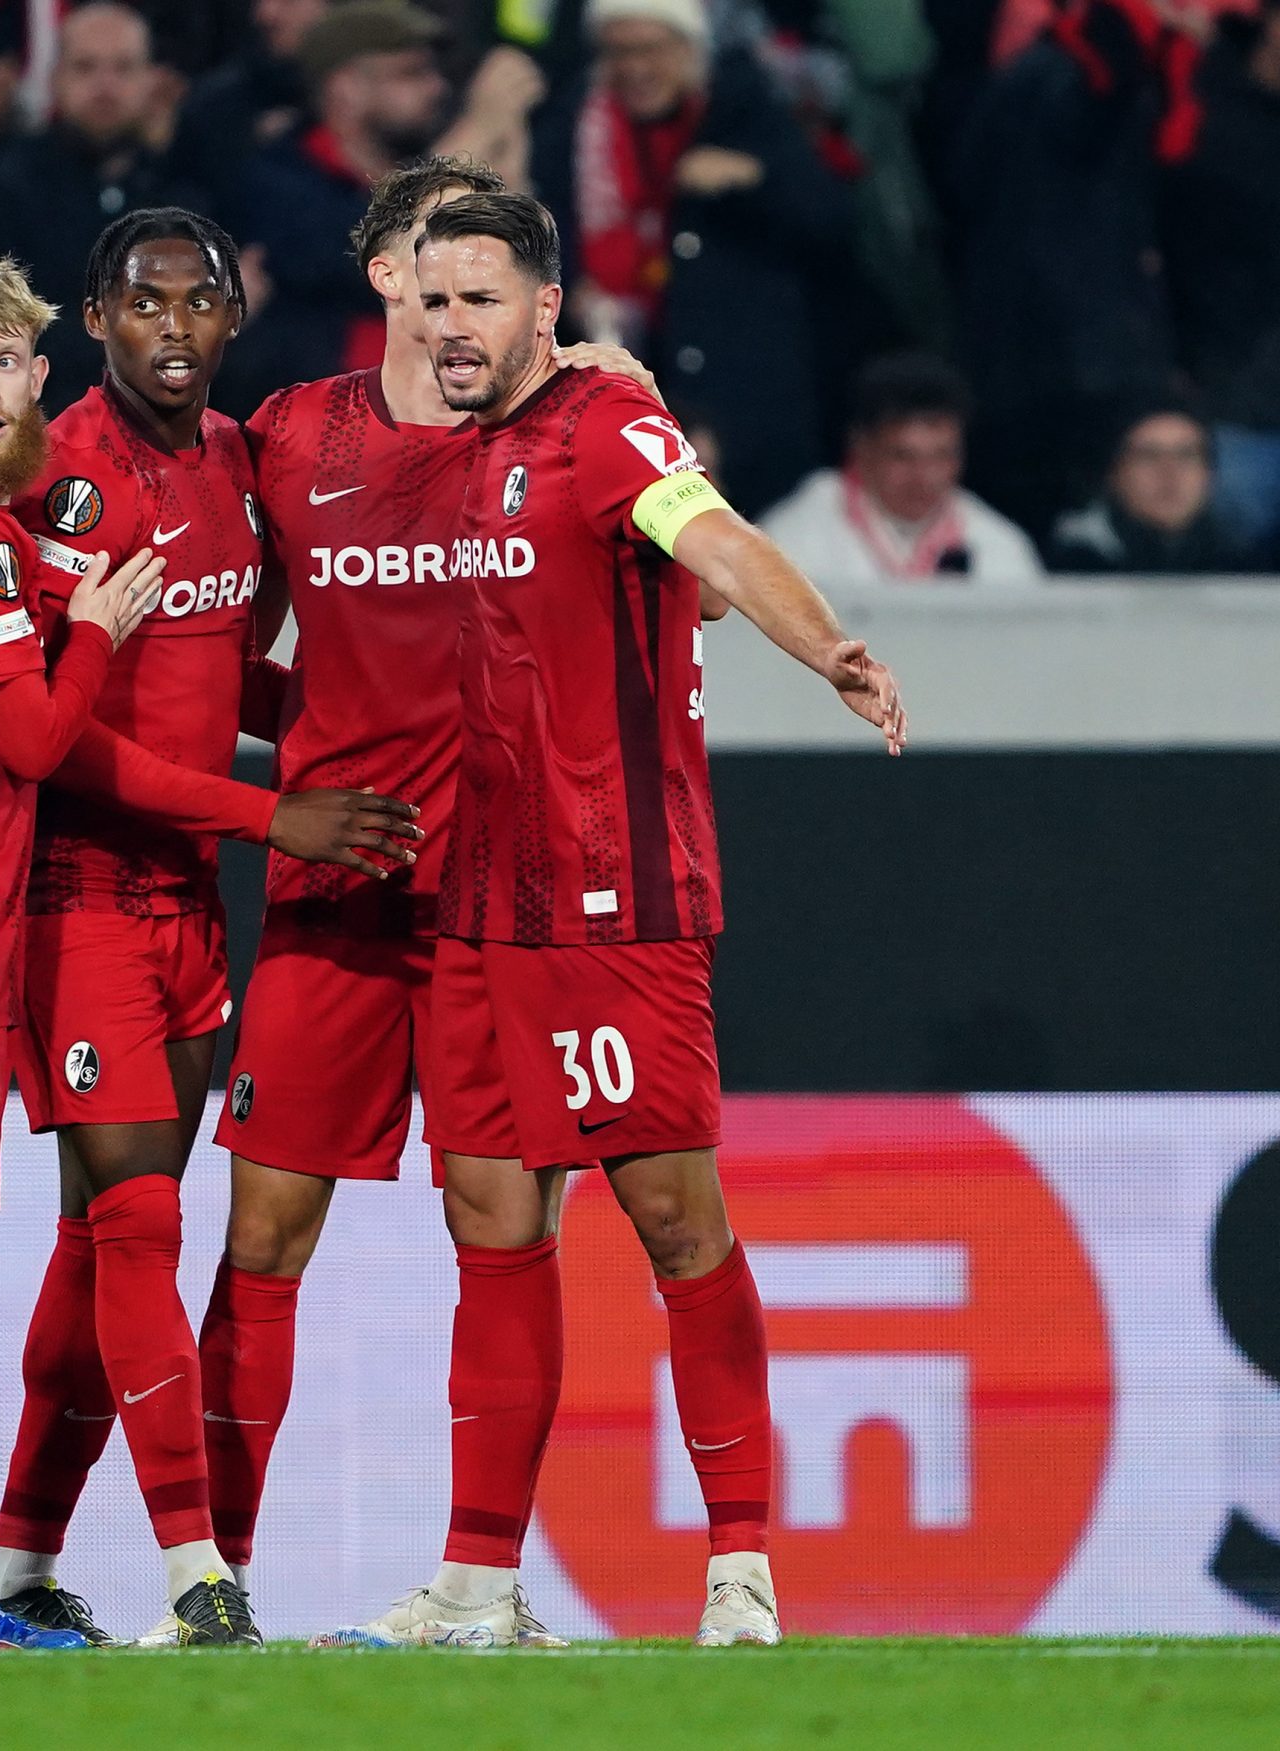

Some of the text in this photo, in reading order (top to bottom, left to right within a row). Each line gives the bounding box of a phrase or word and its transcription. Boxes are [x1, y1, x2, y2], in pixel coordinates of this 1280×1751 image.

[308, 544, 452, 588] JOBR
[449, 537, 536, 578] OBRAD
[142, 564, 263, 618] OBRA
[551, 1025, 635, 1110] 30
